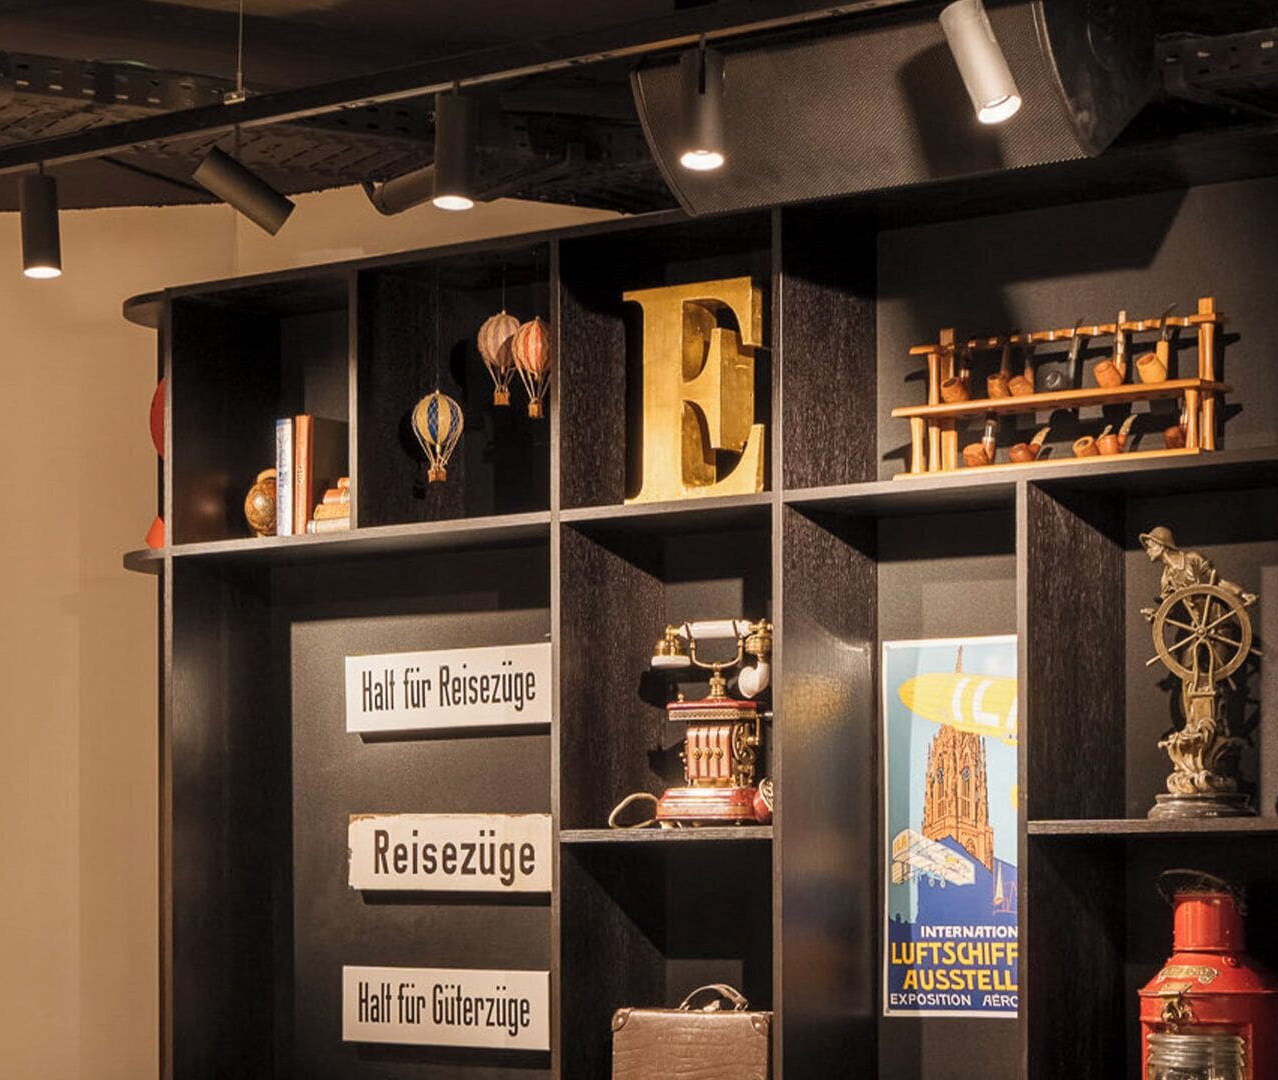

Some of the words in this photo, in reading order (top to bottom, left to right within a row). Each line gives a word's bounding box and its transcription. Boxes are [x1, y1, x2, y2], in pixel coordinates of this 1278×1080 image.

[623, 276, 764, 505] E
[362, 669, 395, 712] Halt
[403, 667, 431, 709] für
[439, 660, 536, 711] Reisezüge
[374, 829, 535, 887] Reisezüge
[921, 925, 1018, 938] INTERNATION
[891, 942, 1018, 965] LUFTSCHIFF
[903, 969, 1018, 991] AUSSTELL
[358, 982, 391, 1023] Halt
[397, 983, 425, 1024] für
[432, 984, 530, 1036] Güterzüge
[890, 993, 971, 1006] EXPOSITION
